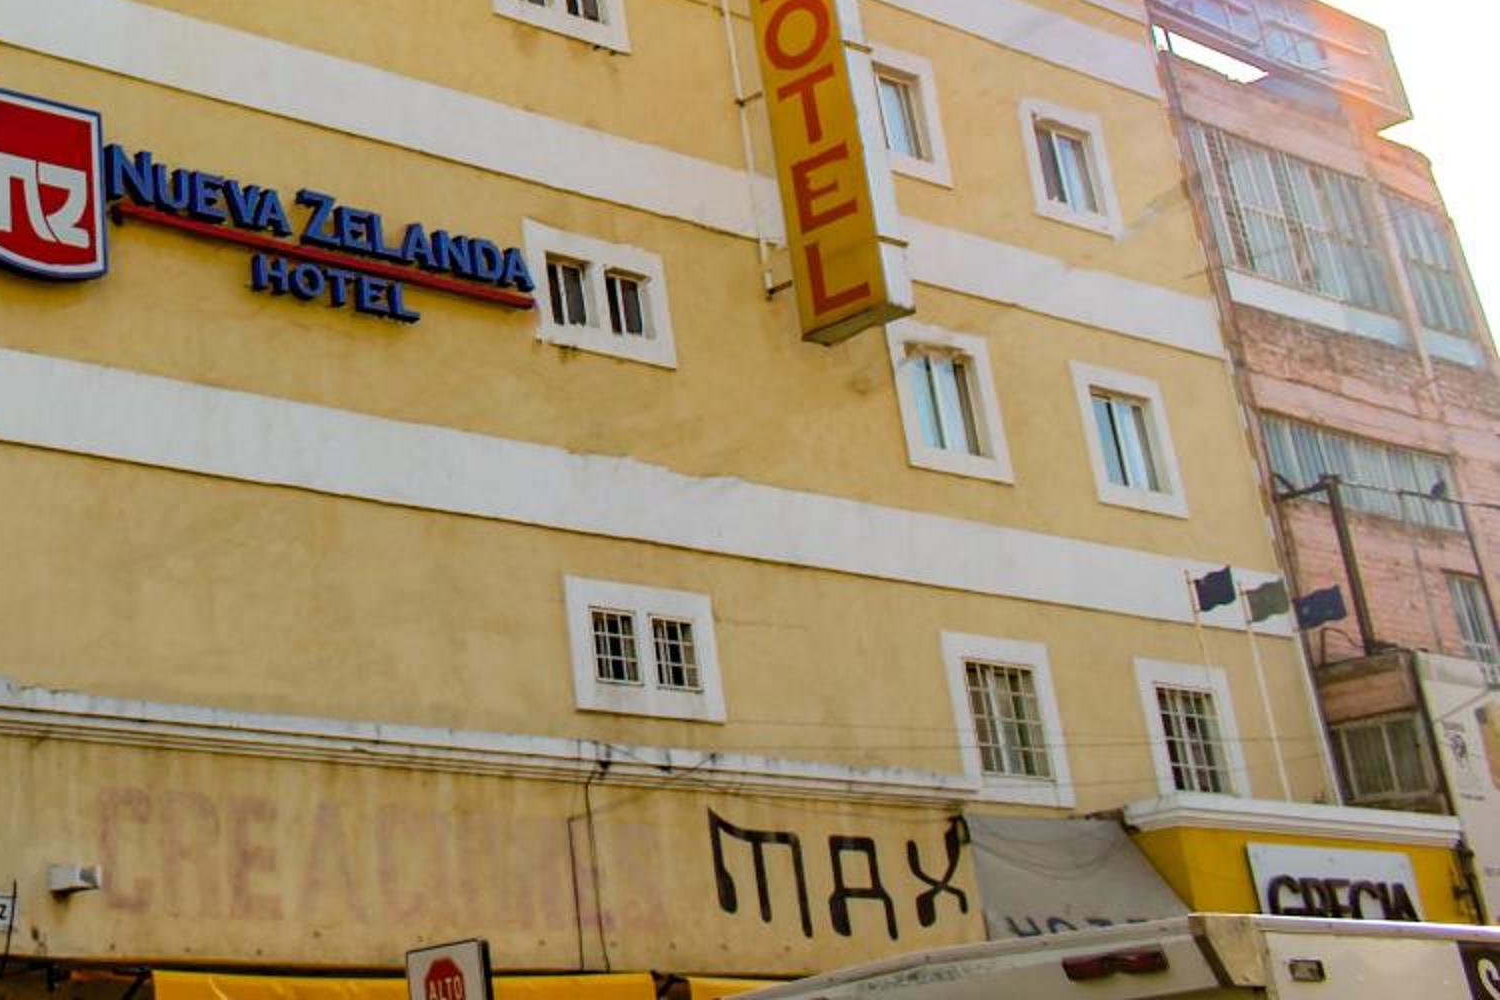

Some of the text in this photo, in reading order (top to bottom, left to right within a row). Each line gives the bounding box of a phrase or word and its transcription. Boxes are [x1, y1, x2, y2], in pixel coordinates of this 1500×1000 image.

[104, 143, 536, 292] NUEVA ZELANDA
[250, 253, 421, 322] HOTEL
